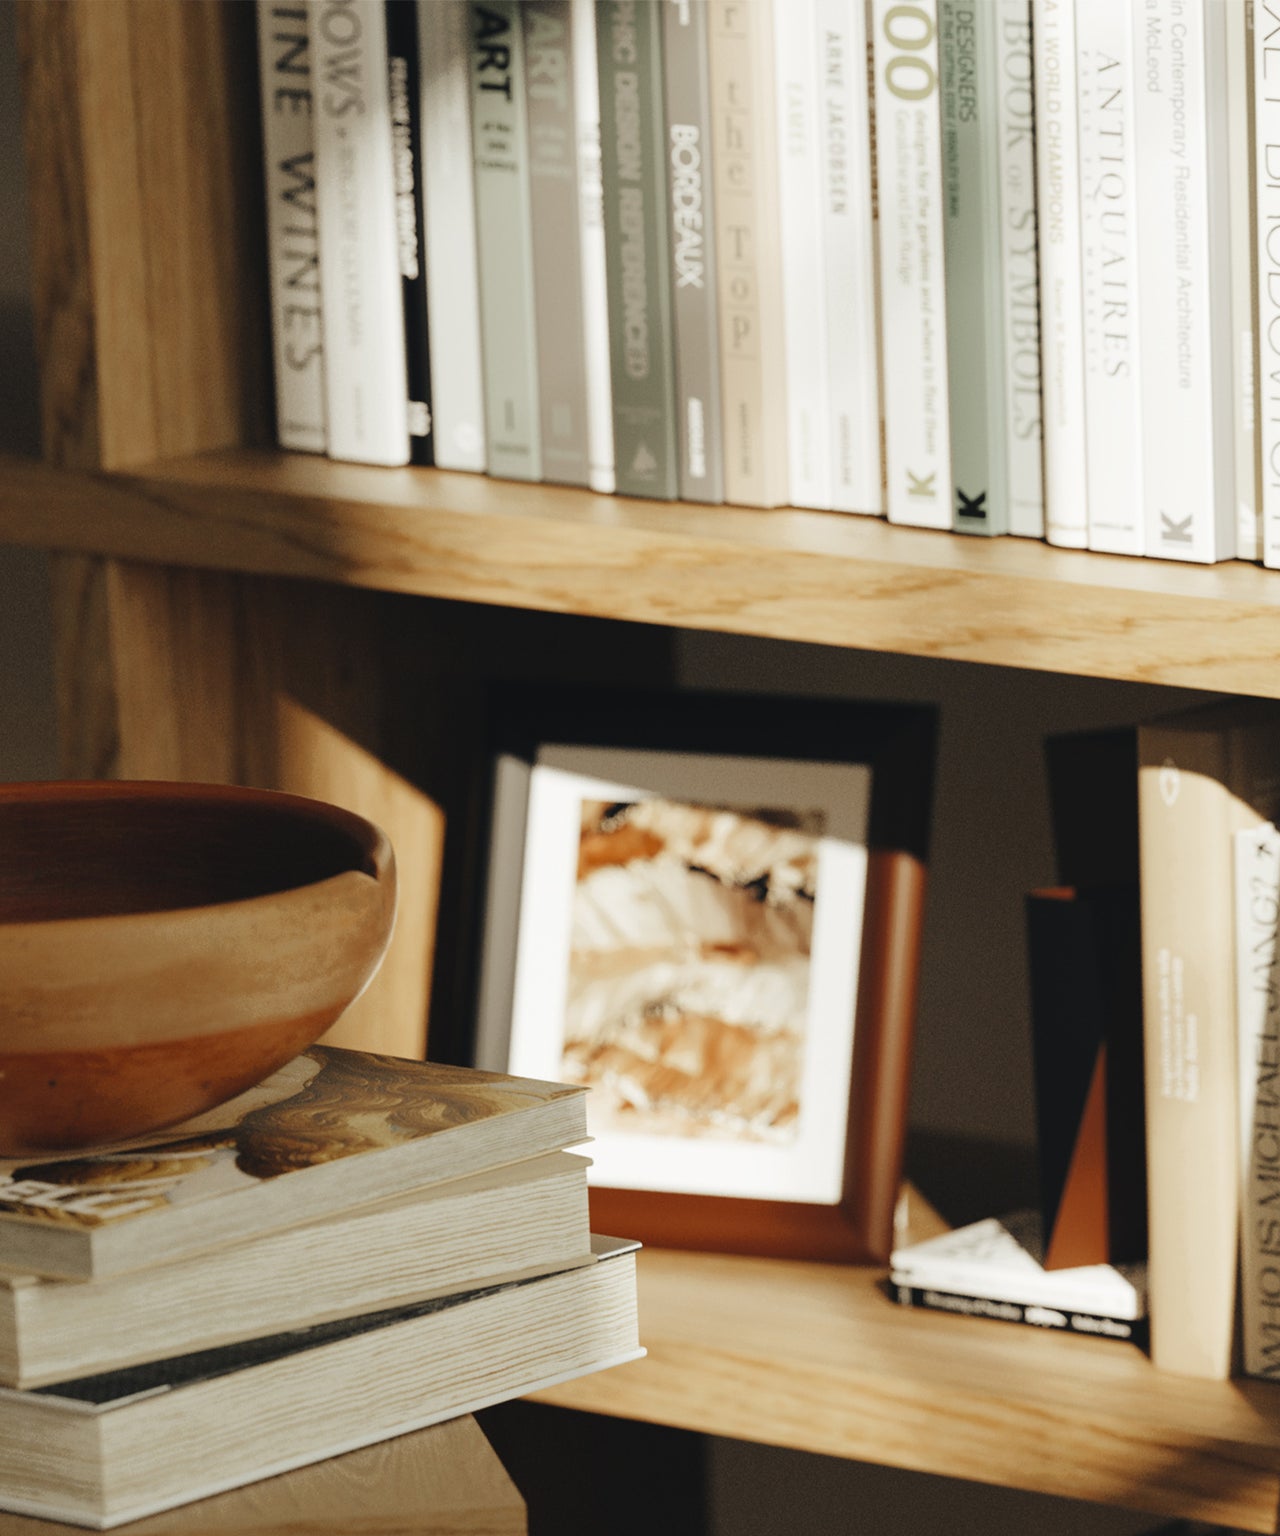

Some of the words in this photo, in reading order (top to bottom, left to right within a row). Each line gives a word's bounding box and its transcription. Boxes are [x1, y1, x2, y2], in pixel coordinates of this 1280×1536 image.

[475, 6, 515, 104] ART
[955, 9, 979, 124] DESIGNERS
[1002, 17, 1036, 152] BOOK
[1044, 37, 1062, 113] WORLD
[1145, 16, 1166, 94] McLeod
[1165, 22, 1189, 159] Contemporary
[670, 124, 704, 289] BORDEAUX
[1046, 120, 1065, 245] CHAMPIONS
[1094, 49, 1131, 381] ANTIQUAIRES
[1172, 165, 1193, 271] Residential
[278, 150, 322, 374] WINES
[1007, 205, 1043, 443] SYMBOLS
[1175, 276, 1196, 391] Architecture
